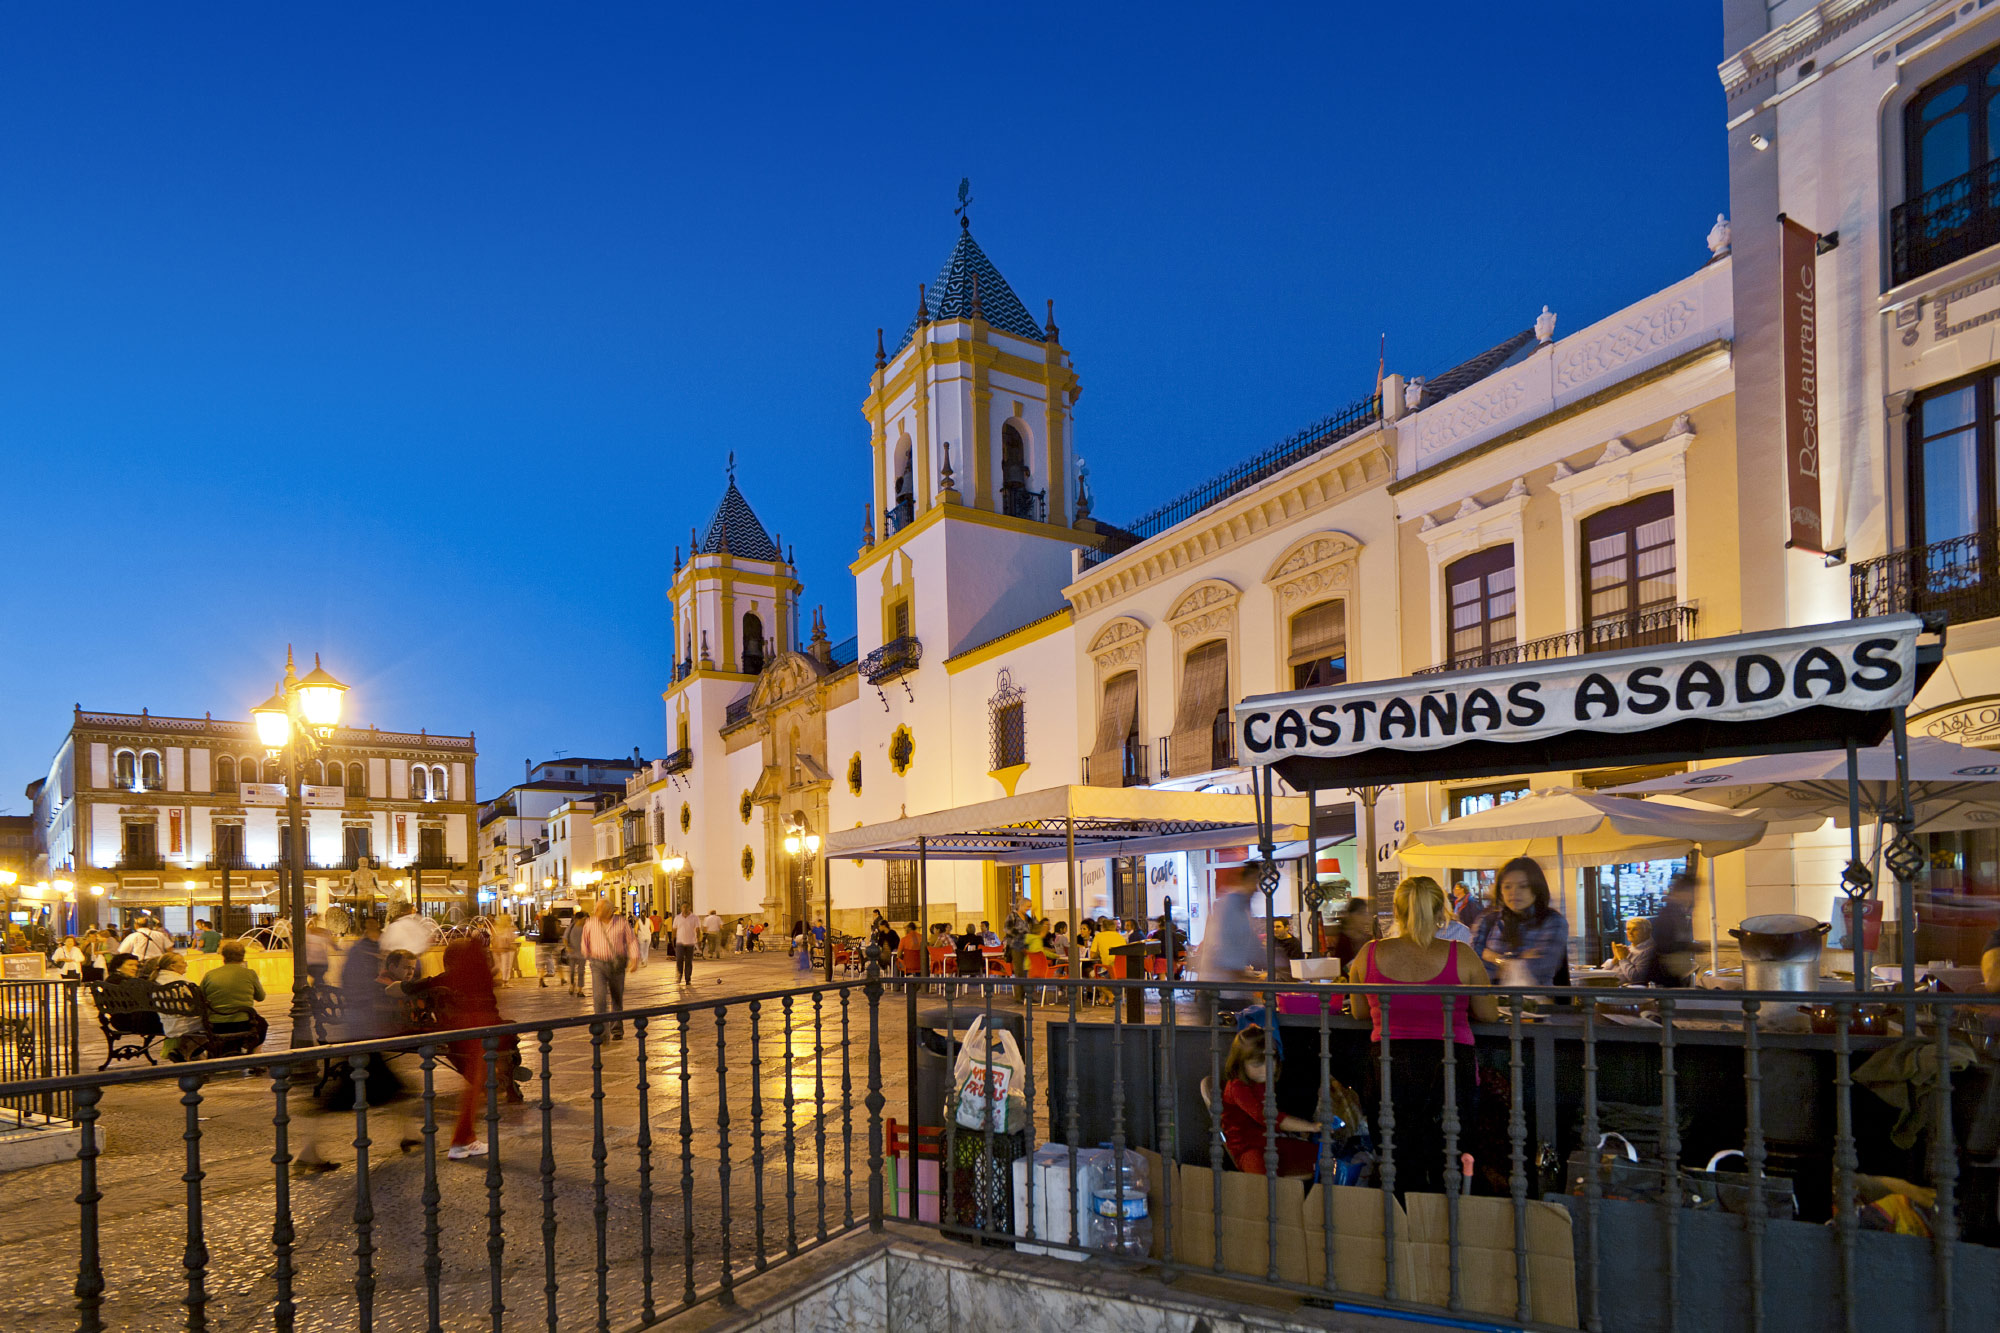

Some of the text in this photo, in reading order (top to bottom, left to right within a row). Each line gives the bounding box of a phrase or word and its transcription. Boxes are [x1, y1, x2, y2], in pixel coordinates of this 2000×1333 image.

[1796, 264, 1818, 480] Restaurante
[1243, 638, 1903, 753] CASTAÑAS ASADAS
[1927, 707, 2000, 738] CASA O
[1083, 866, 1106, 887] Tapas
[1150, 857, 1174, 885] Café
